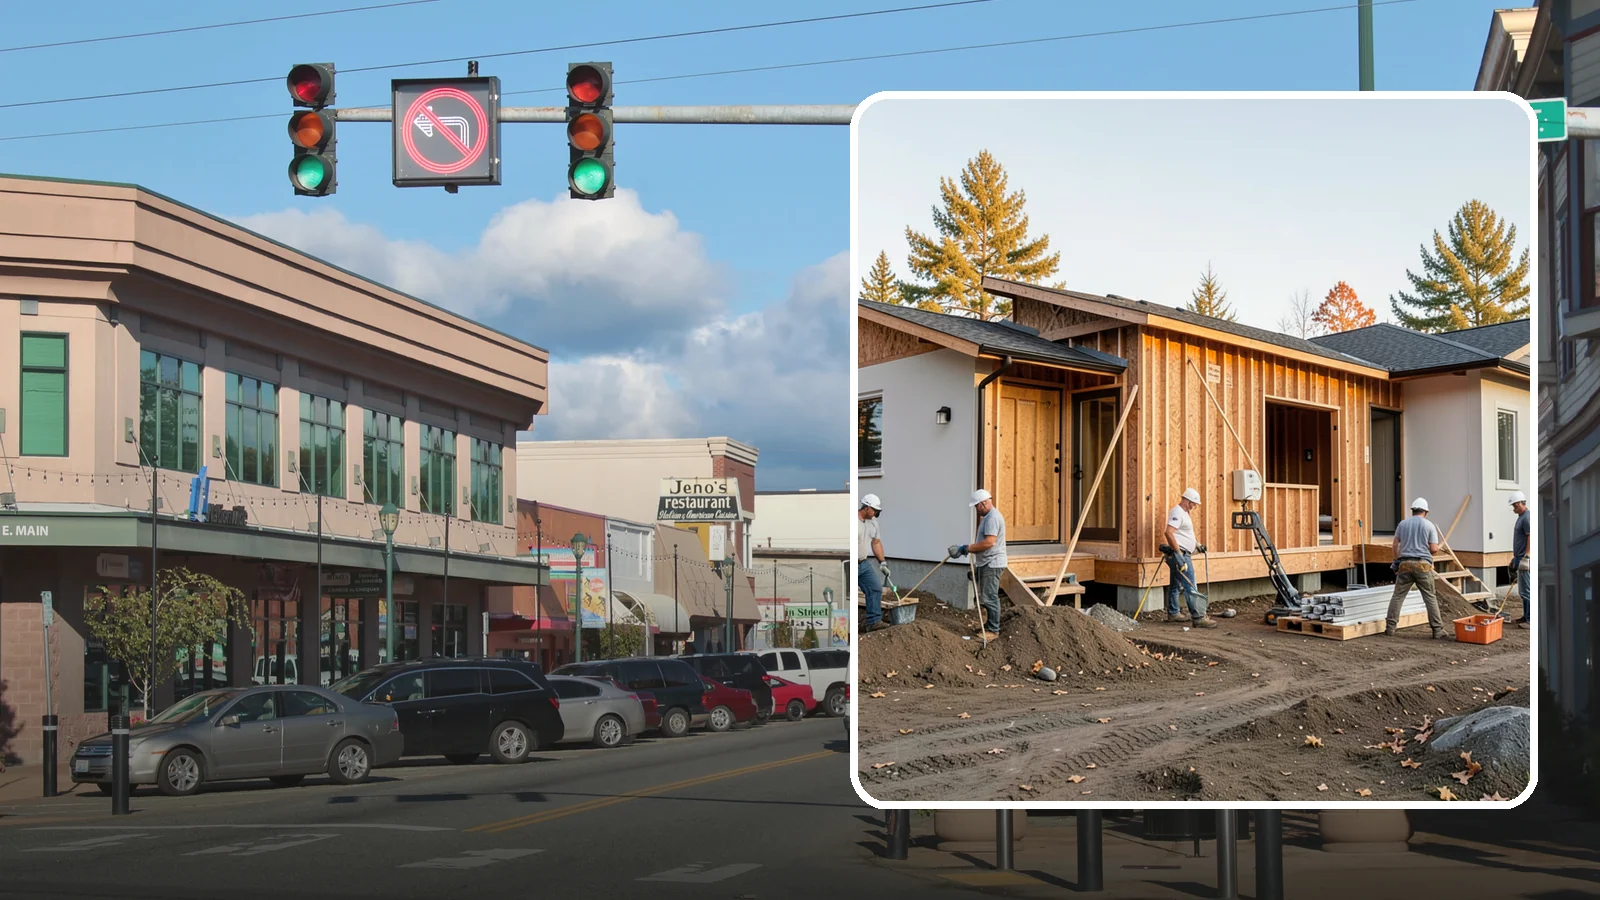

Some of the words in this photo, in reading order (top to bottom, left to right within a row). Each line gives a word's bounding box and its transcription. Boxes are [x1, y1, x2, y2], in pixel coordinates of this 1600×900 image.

[669, 479, 728, 495] Jeno's
[664, 496, 731, 509] restaurant
[658, 509, 681, 519] Italian
[686, 509, 714, 519] American
[715, 509, 738, 519] Cuisine
[2, 525, 13, 536] E.
[15, 525, 49, 536] MAIN
[797, 607, 828, 617] Street
[791, 619, 823, 627] lass
